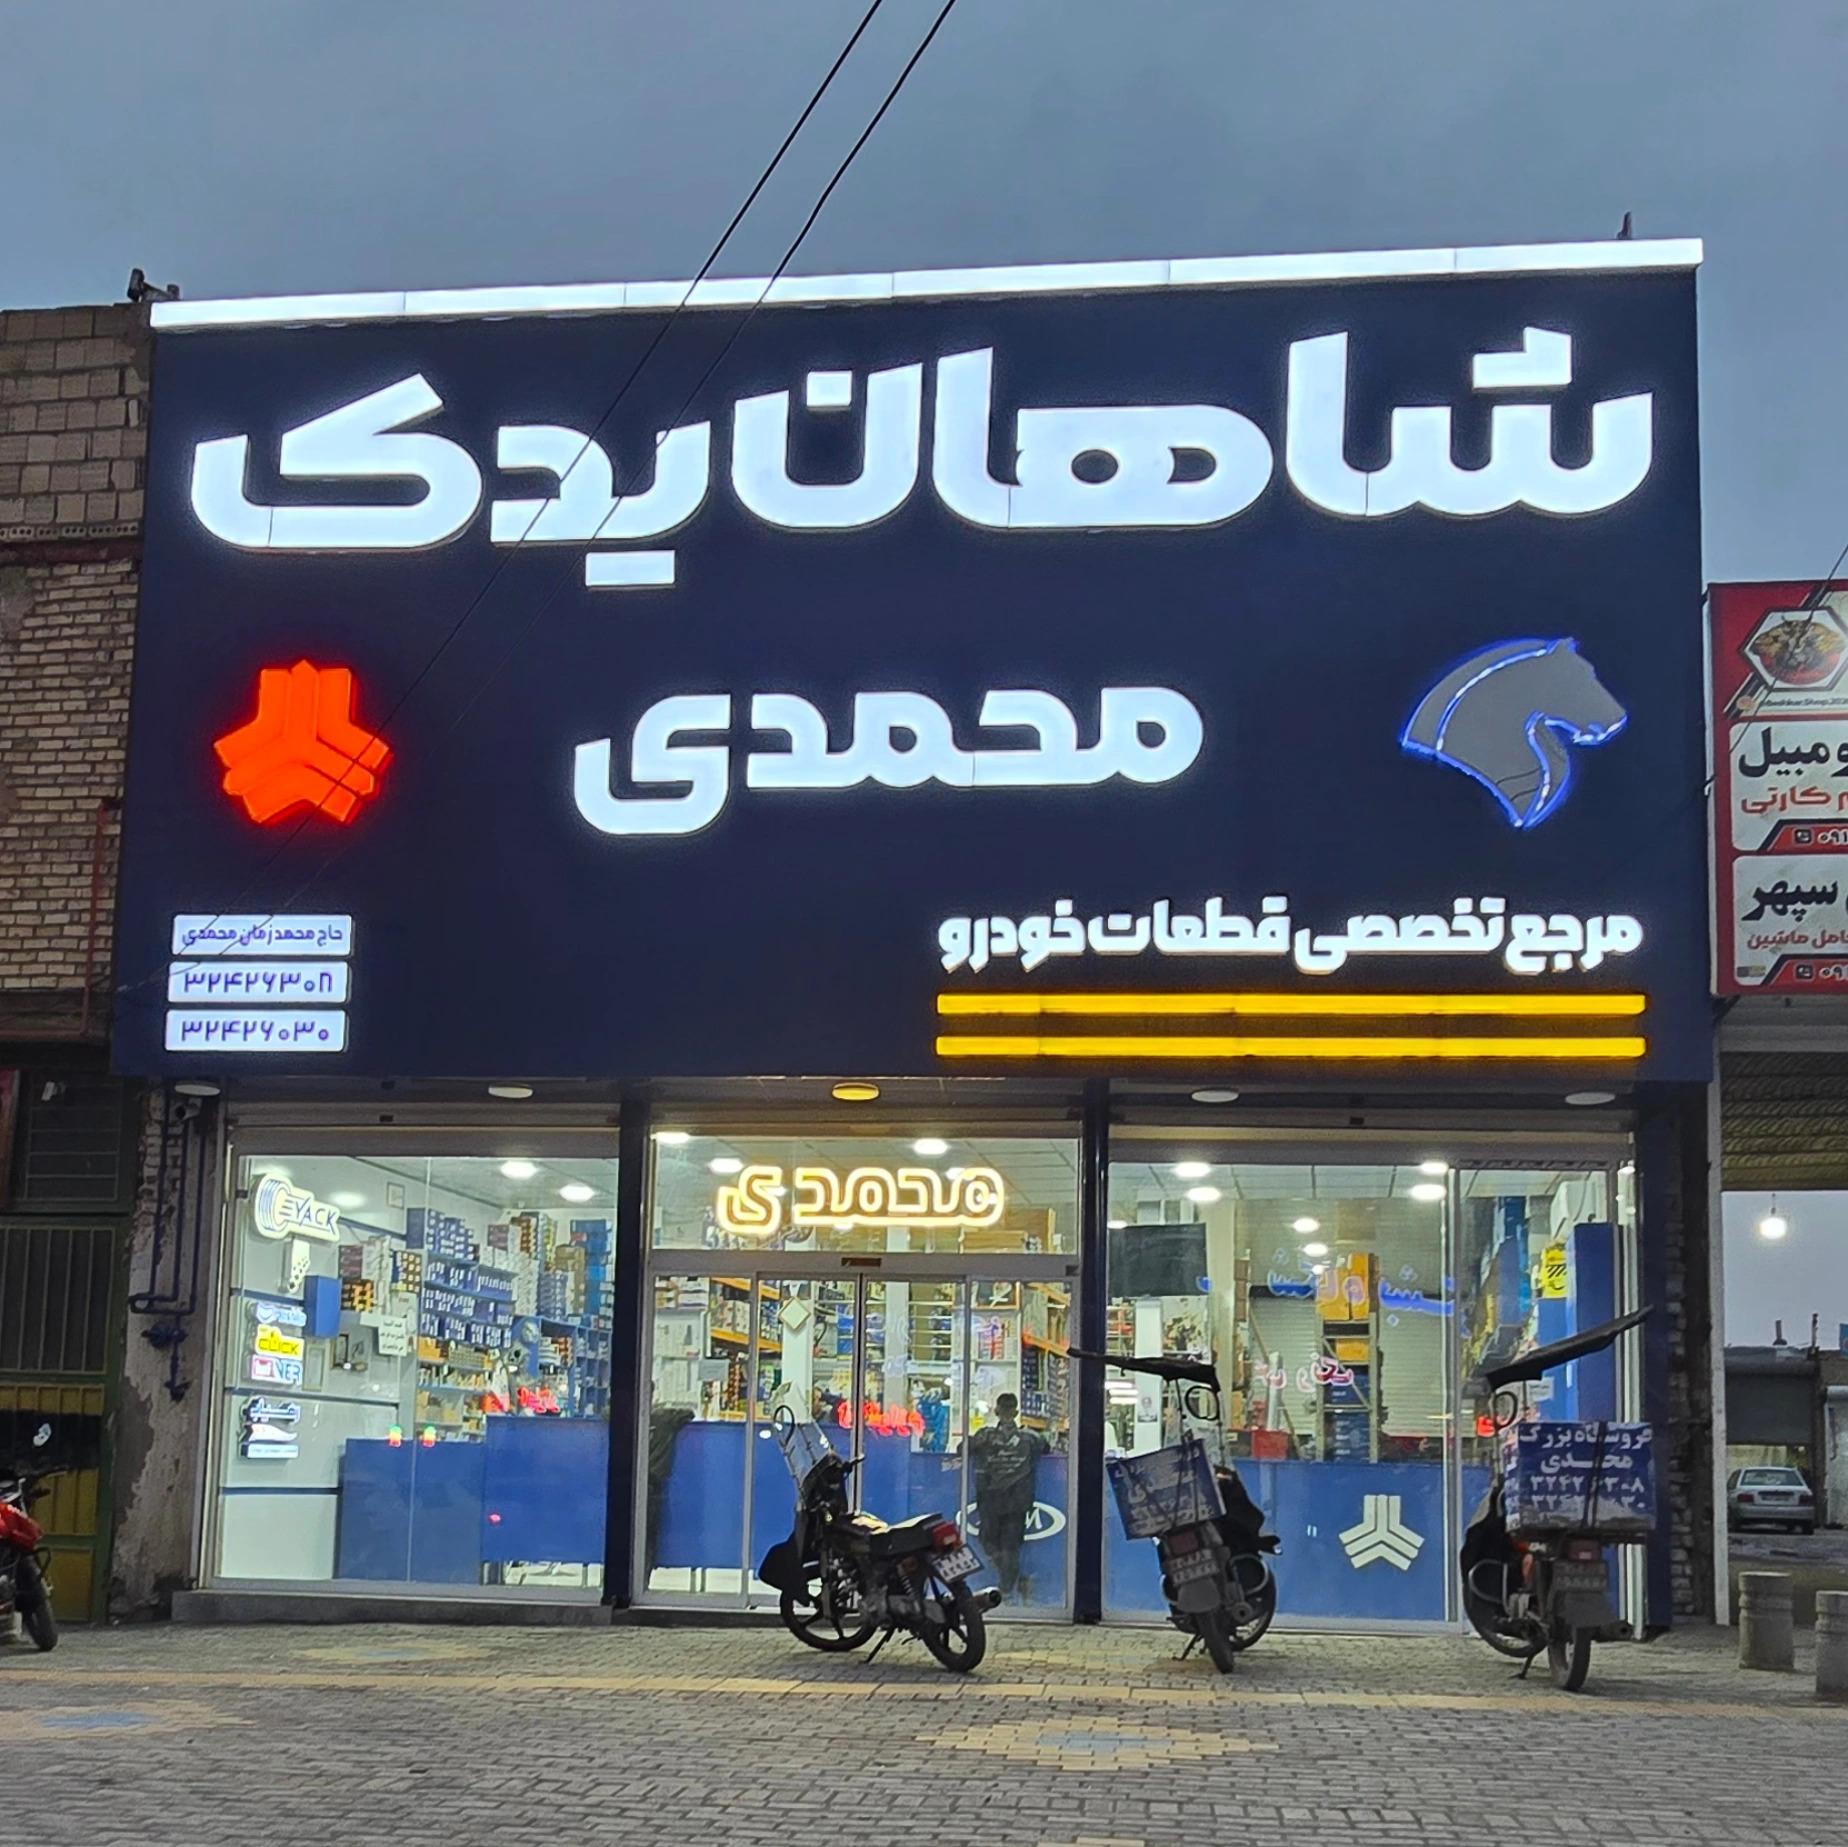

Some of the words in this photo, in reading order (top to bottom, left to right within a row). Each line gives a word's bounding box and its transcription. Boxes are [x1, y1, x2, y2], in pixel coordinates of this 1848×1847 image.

[730, 325, 1654, 530] شاهان
[190, 373, 711, 588] یدک
[573, 684, 1204, 837] محمدی
[1088, 895, 1290, 954] قطعات
[1741, 880, 1838, 922] سپهر
[275, 929, 315, 940] محمد
[317, 924, 343, 947] حاج
[937, 898, 1086, 973] خودرو
[1294, 896, 1506, 975] تخصصی
[1504, 912, 1642, 975] مرجع
[181, 1019, 330, 1042] ۳۲۴۲۶۰۳۰
[716, 1166, 1005, 1235] محمدی
[1540, 1452, 1633, 1474] محدی
